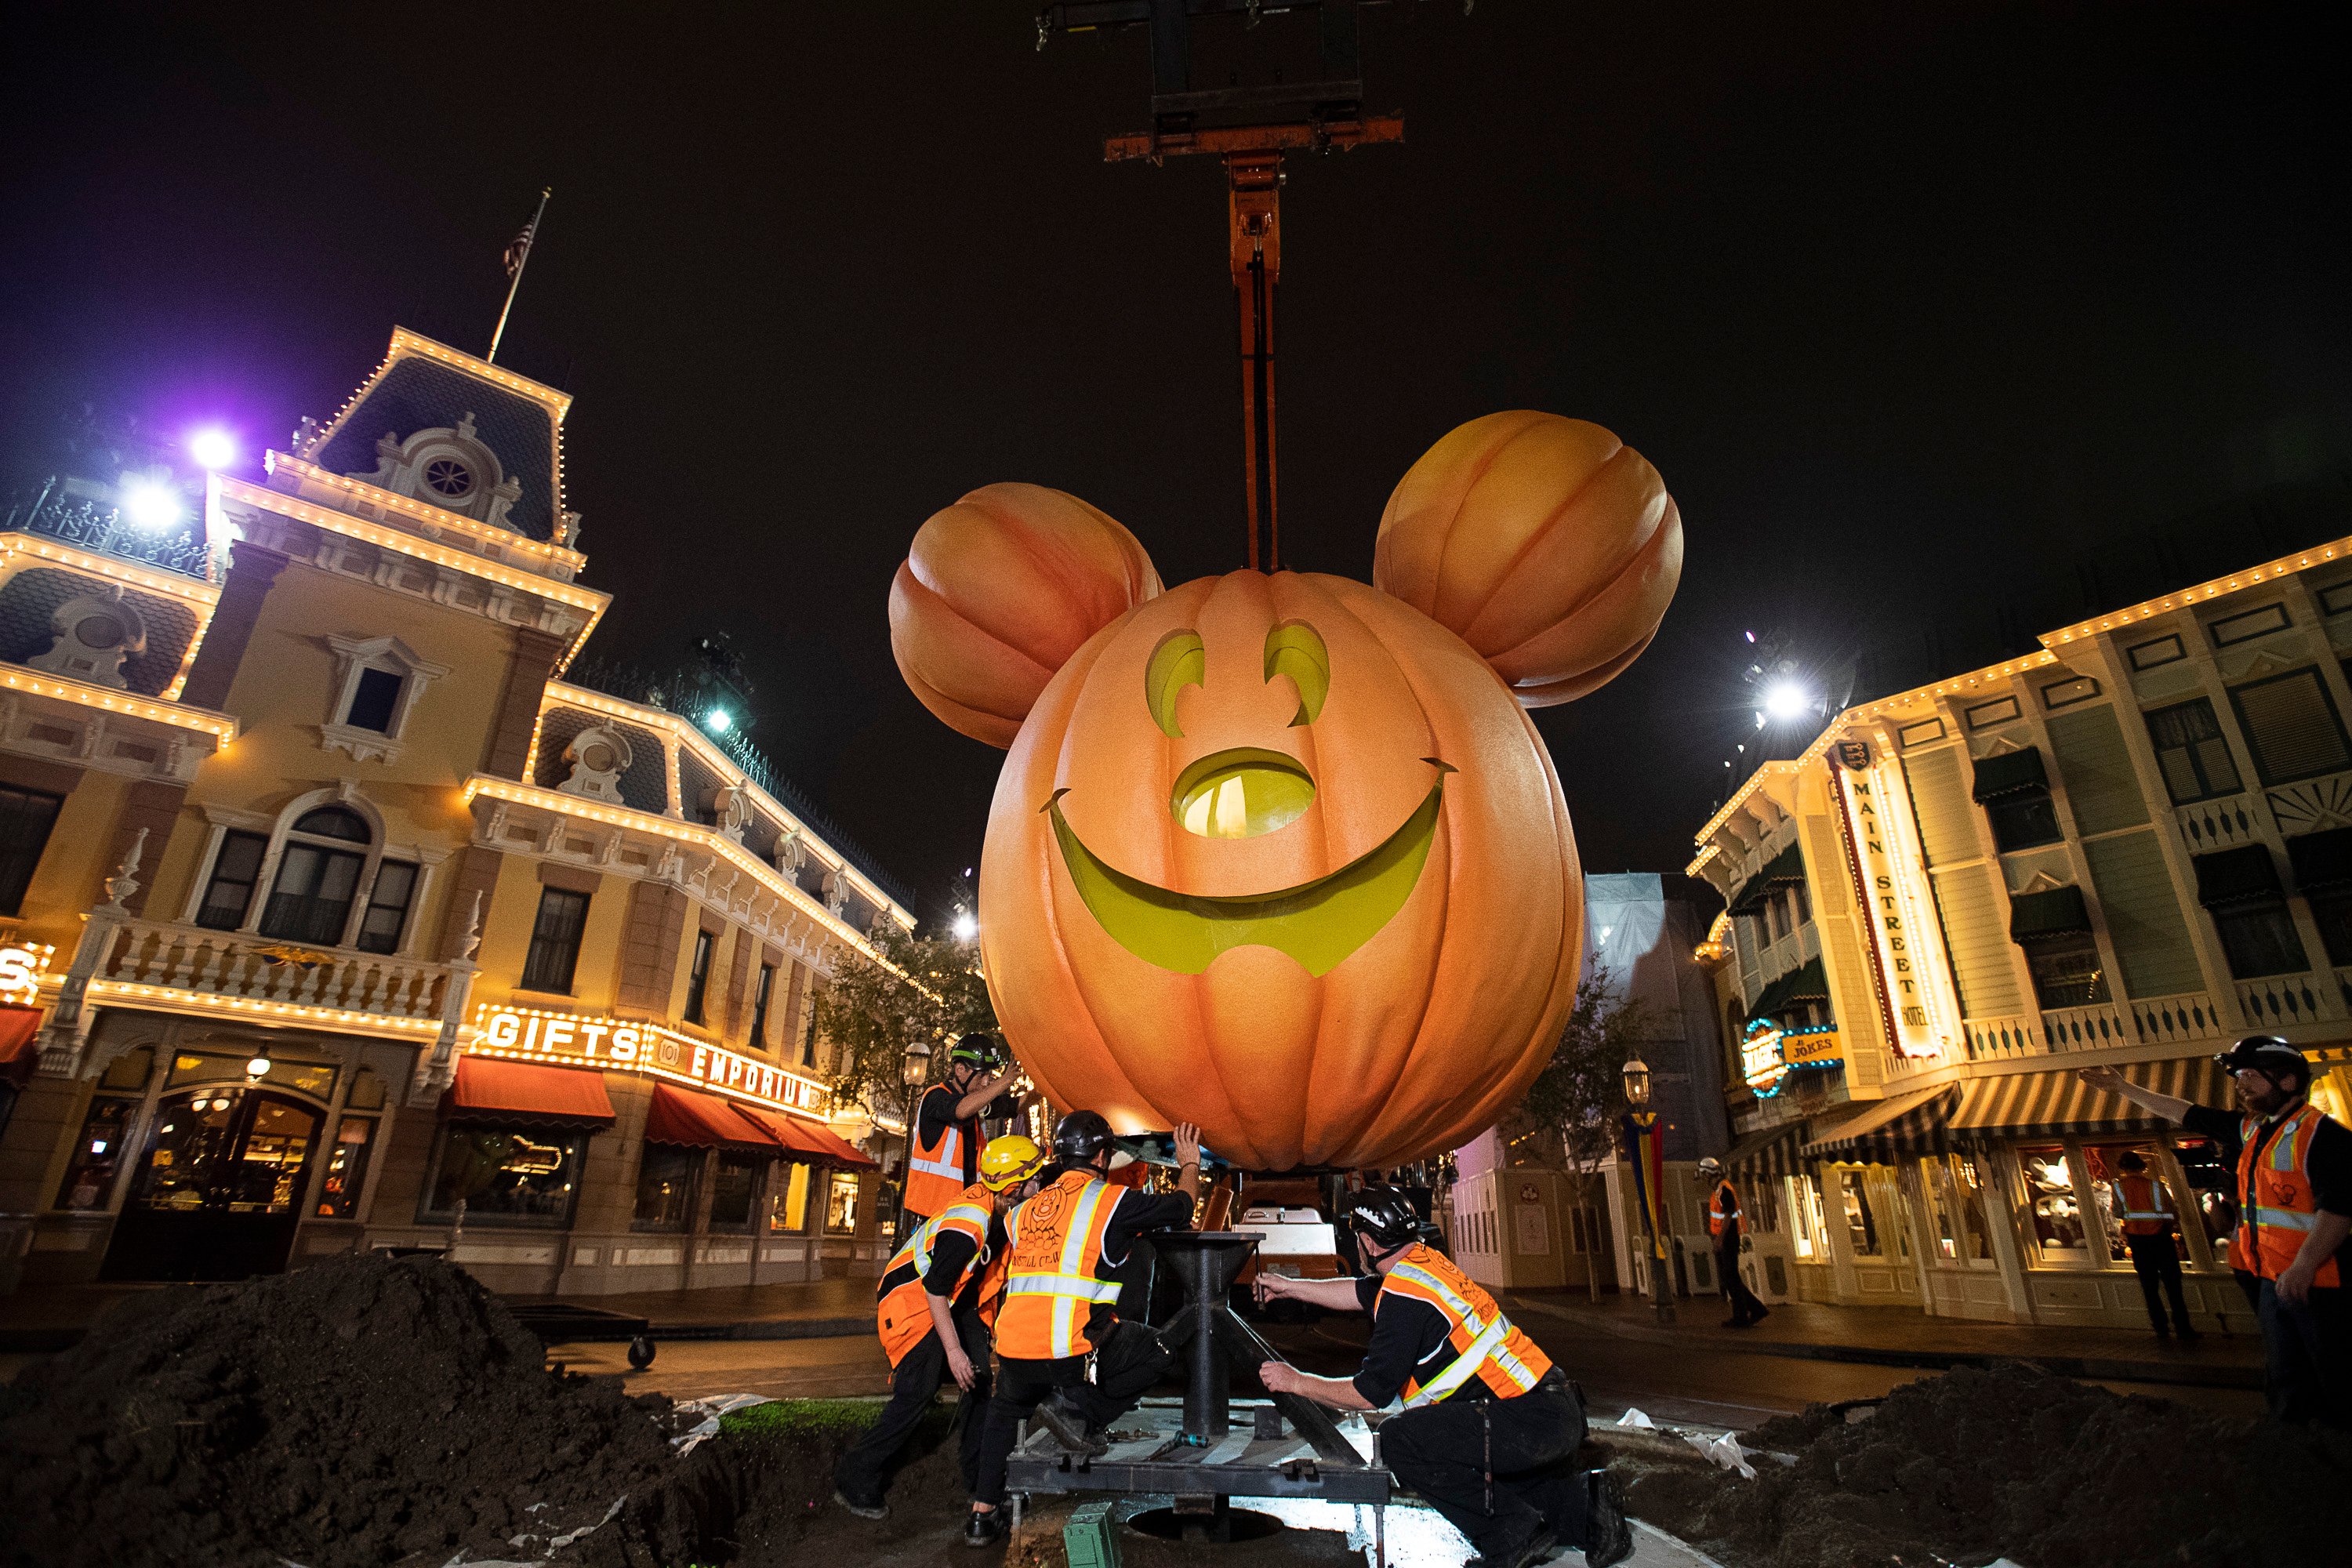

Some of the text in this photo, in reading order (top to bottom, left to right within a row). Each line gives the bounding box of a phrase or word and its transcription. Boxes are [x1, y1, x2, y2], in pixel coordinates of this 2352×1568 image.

[1853, 783, 1915, 993] MAIN STREET
[487, 1013, 640, 1060] GIFTS
[1900, 1007, 1929, 1025] HOTEL
[1794, 1039, 1832, 1058] JOKES
[691, 1046, 811, 1109] EMPORIUM
